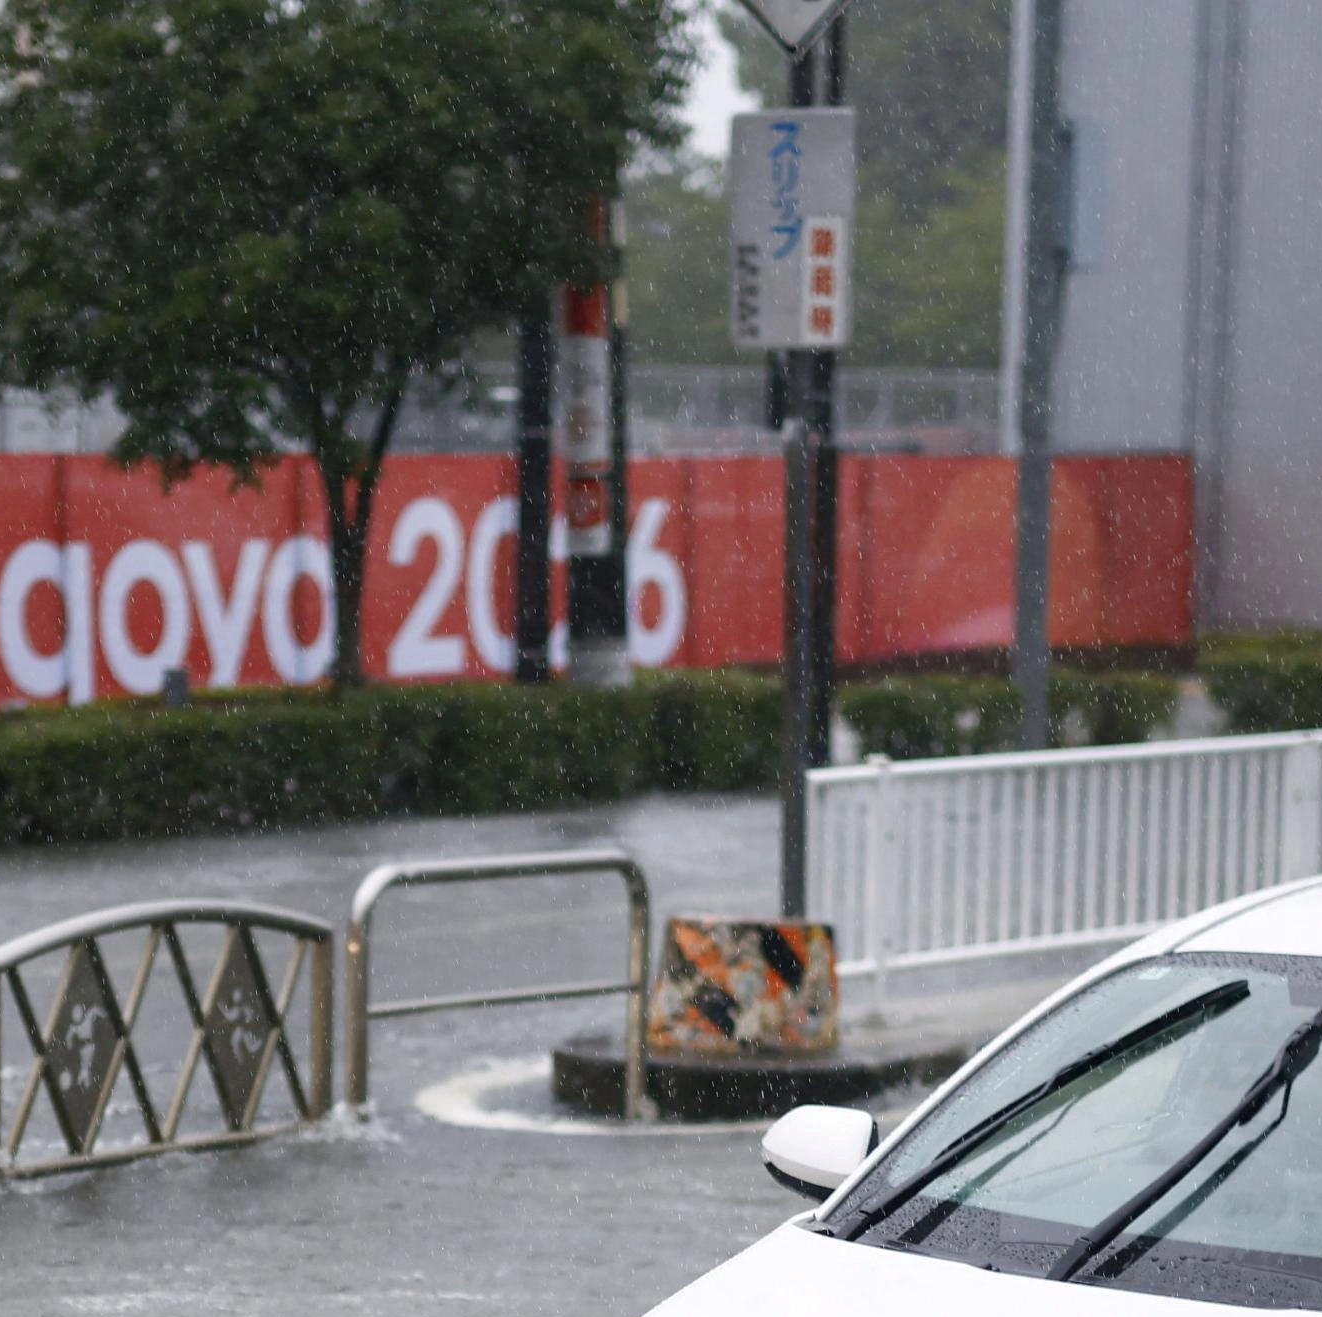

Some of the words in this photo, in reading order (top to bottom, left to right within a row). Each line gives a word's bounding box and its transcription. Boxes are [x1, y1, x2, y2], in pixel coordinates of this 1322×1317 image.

[768, 121, 804, 260] スリップ
[386, 495, 688, 678] 206
